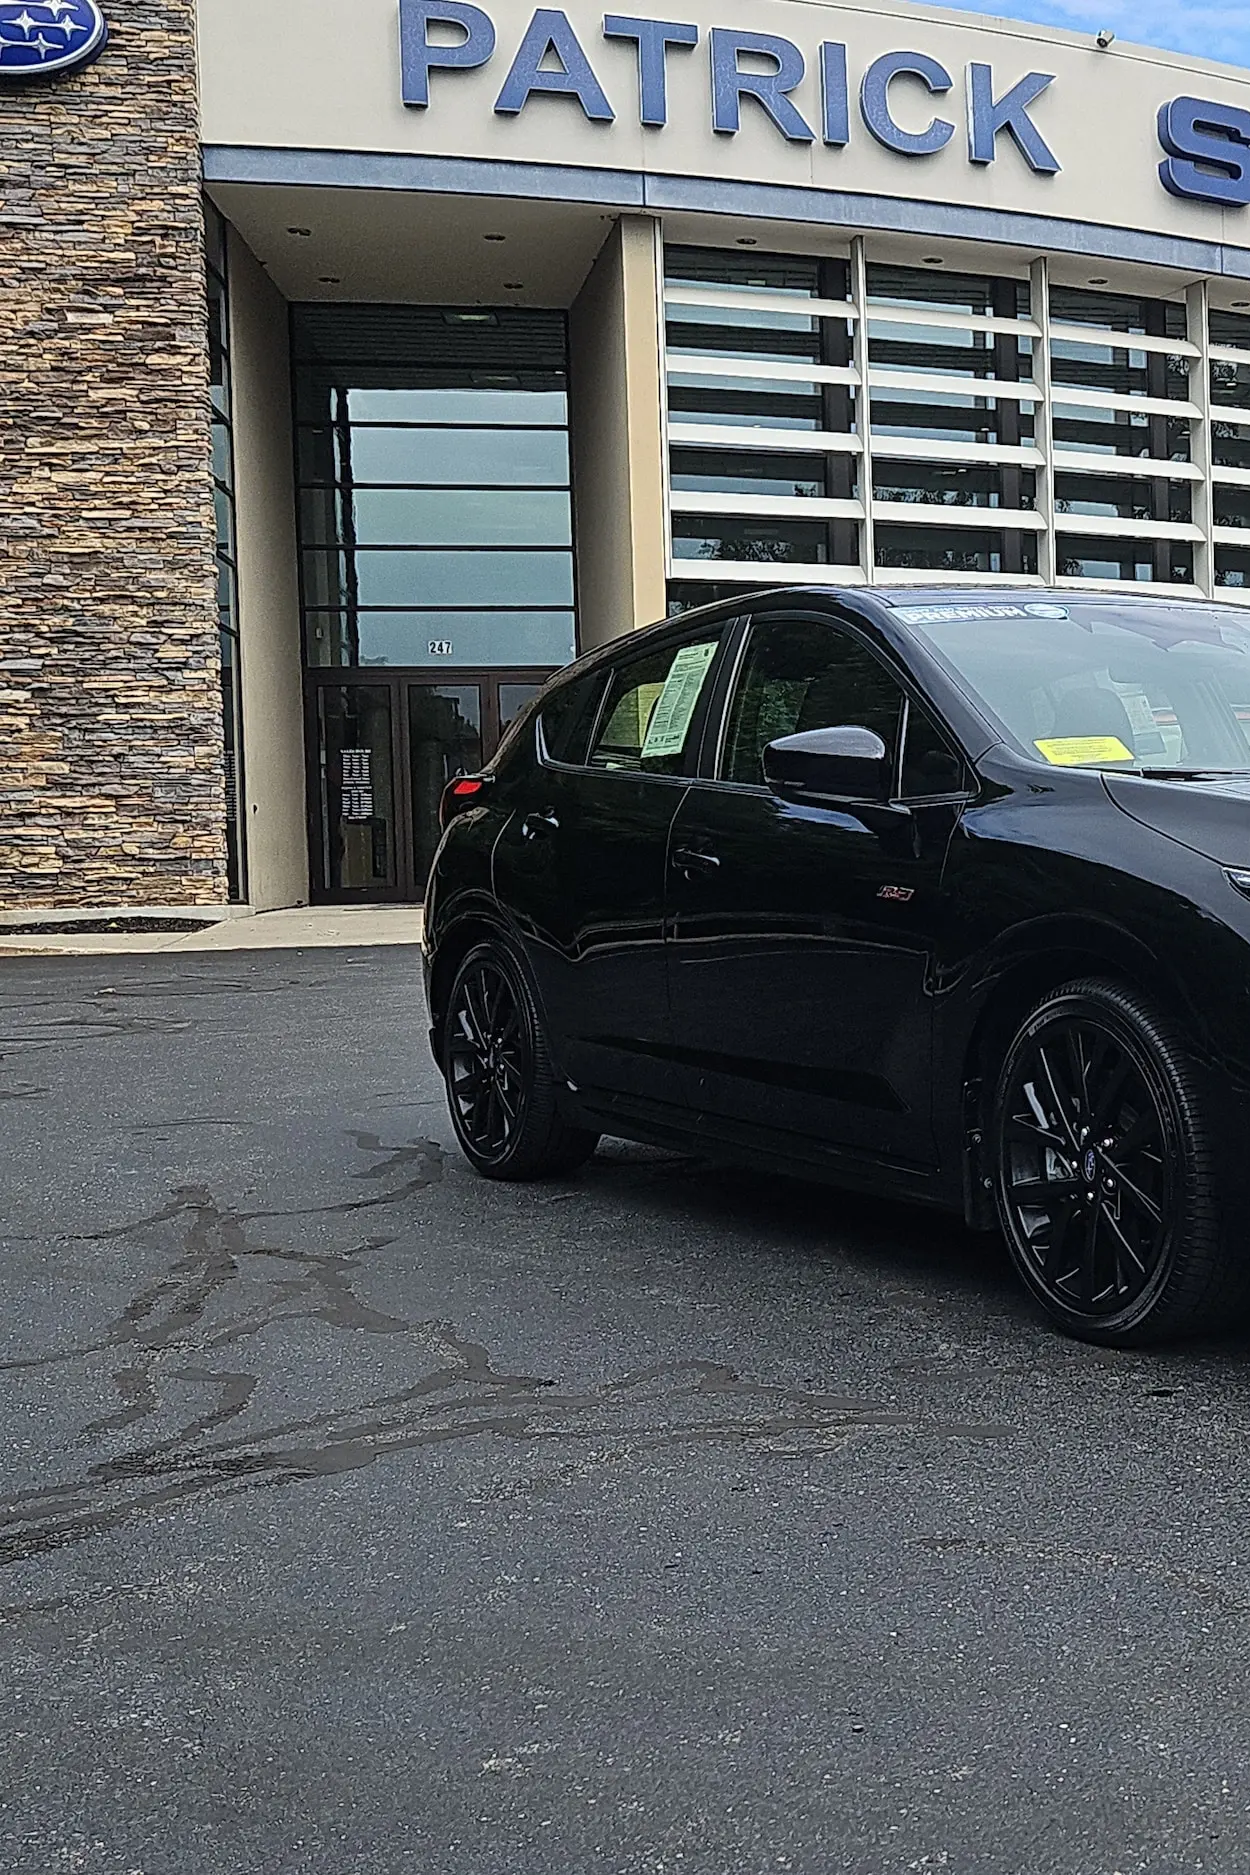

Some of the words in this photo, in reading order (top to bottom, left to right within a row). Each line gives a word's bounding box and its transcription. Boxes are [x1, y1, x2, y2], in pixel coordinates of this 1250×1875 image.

[398, 0, 1062, 175] PATRICK
[906, 606, 1027, 621] PREMIUM
[429, 641, 451, 654] 247
